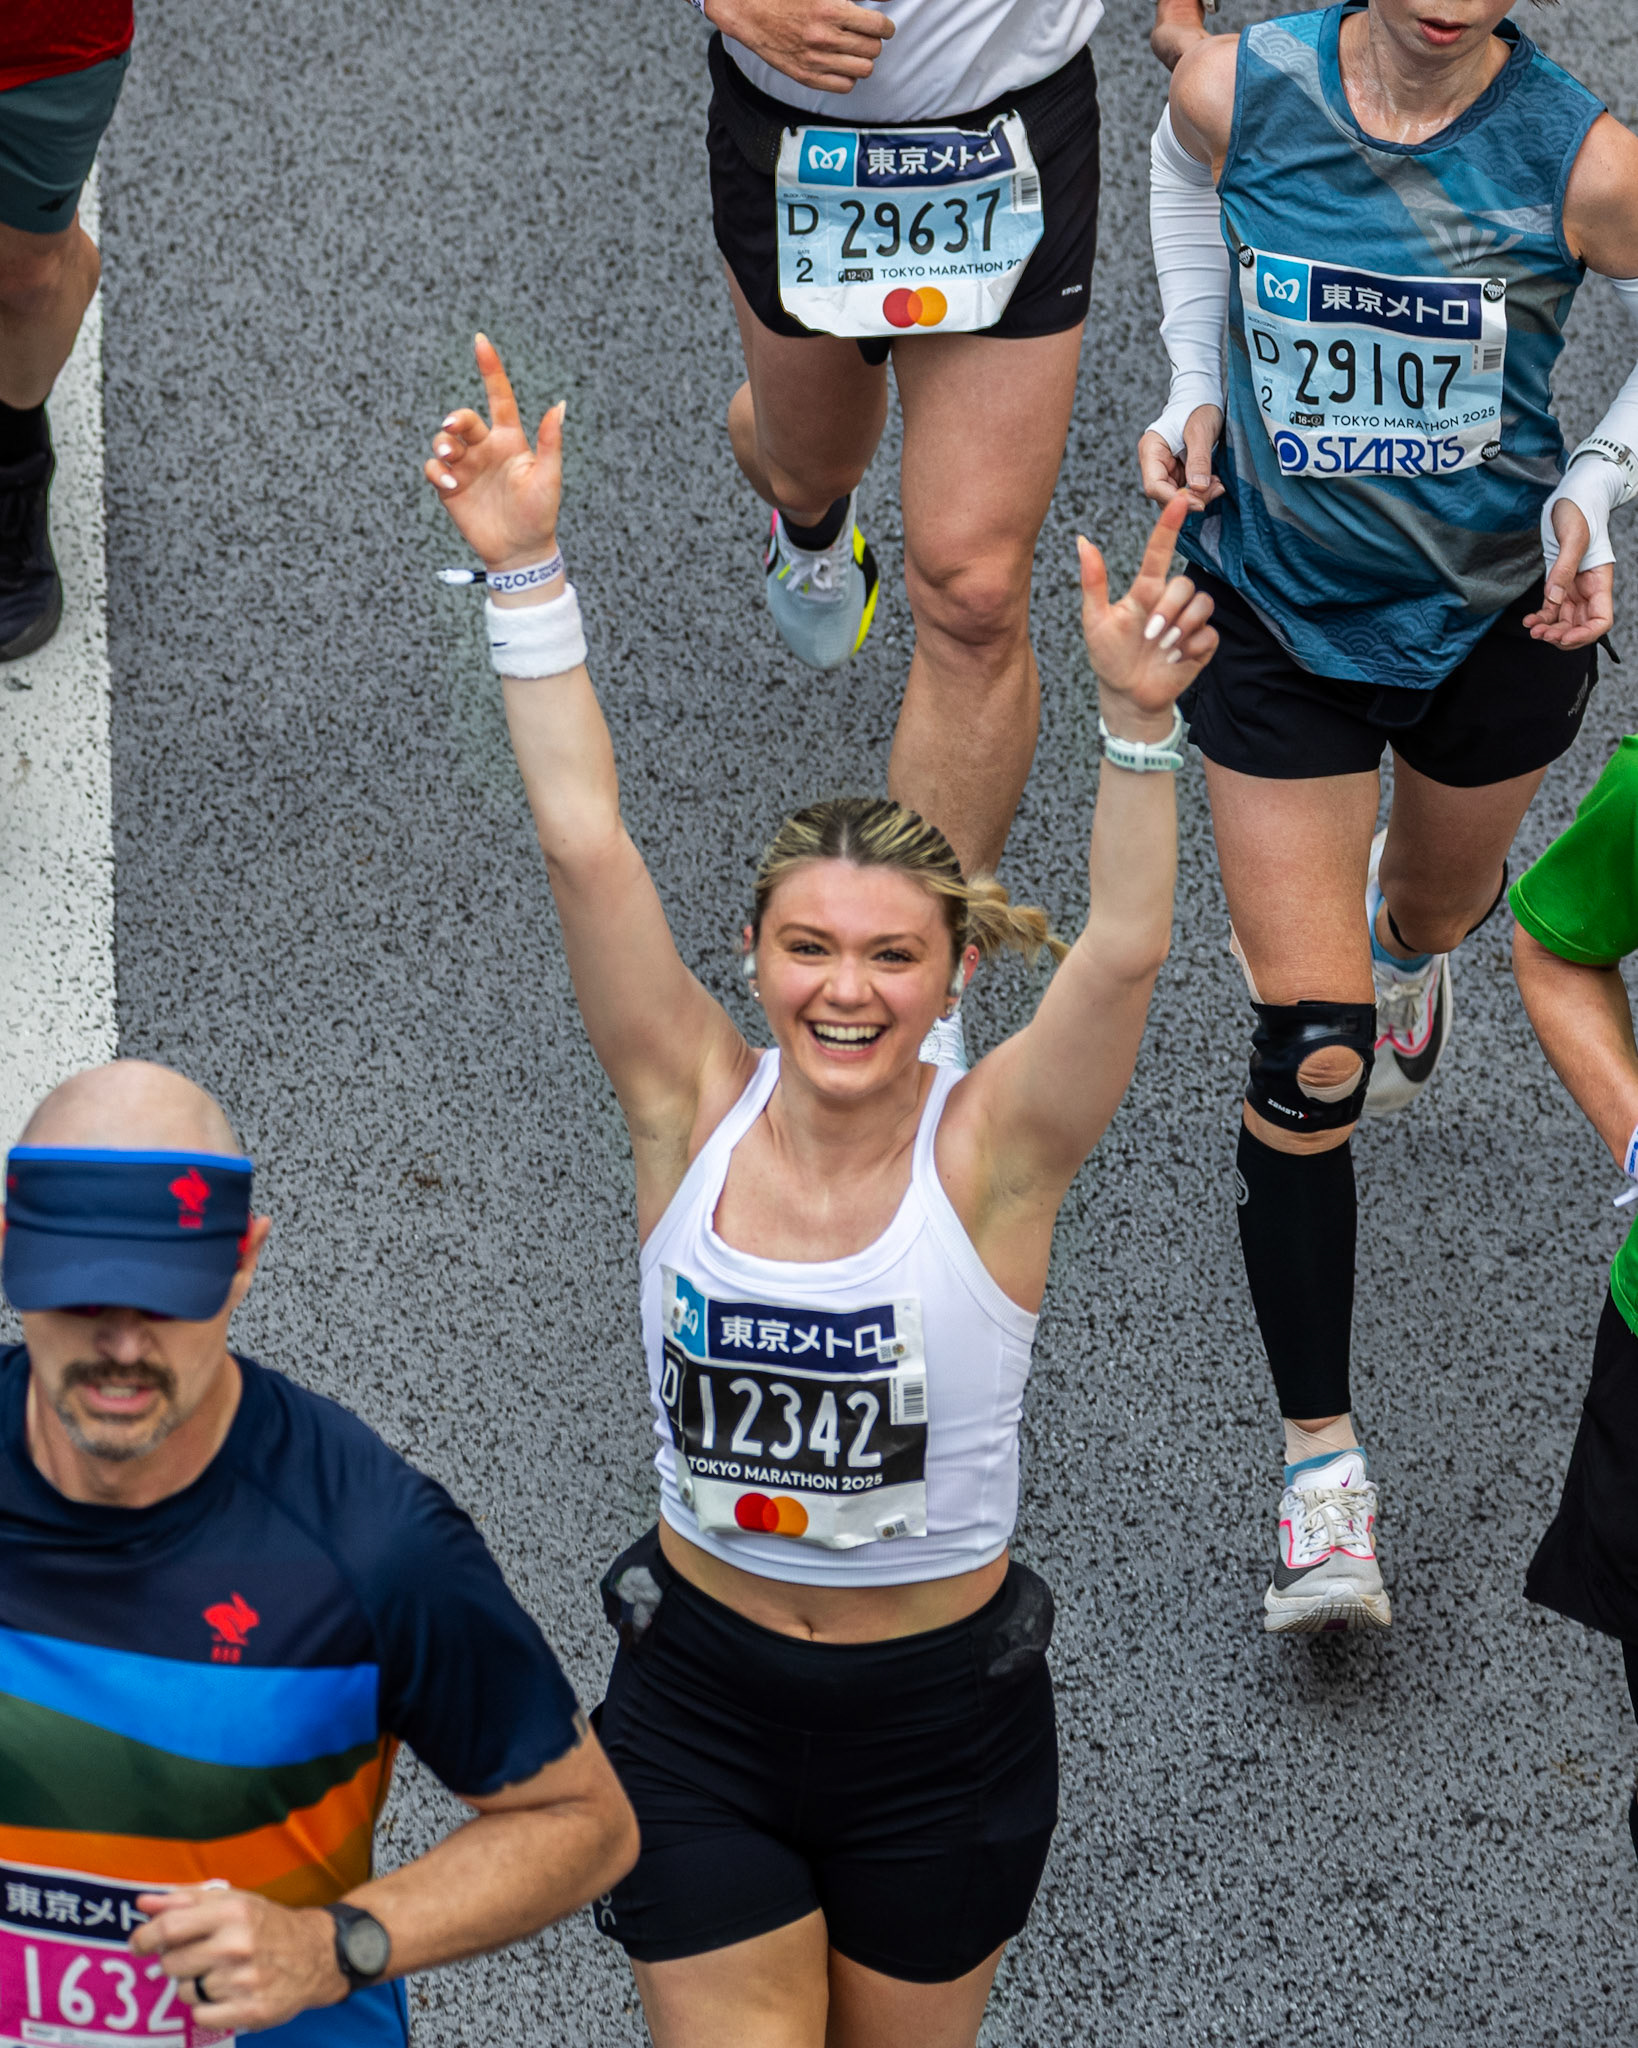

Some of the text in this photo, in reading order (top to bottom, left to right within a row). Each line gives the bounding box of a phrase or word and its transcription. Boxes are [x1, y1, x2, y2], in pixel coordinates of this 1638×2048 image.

[866, 139, 1003, 175] 東京メトロ
[788, 203, 819, 236] D
[840, 187, 1001, 259] 29637
[796, 257, 814, 283] 2
[880, 266, 926, 279] TOKYO
[929, 260, 1003, 276] MARATHON
[1321, 283, 1469, 326] 東京メトロ
[1252, 328, 1280, 365] D
[1292, 338, 1461, 410] 29107
[1261, 385, 1273, 414] 2
[1332, 406, 1496, 432] TOKYO MARATHON 2025
[493, 570, 538, 591] 2025
[719, 1314, 883, 1359] 東京メトロ
[661, 1358, 680, 1407] D
[698, 1374, 884, 1469] 12342
[688, 1455, 884, 1491] TOKYO MARATHON 2025
[5, 1881, 149, 1932] 東京メト
[24, 1944, 185, 2032] 1632
